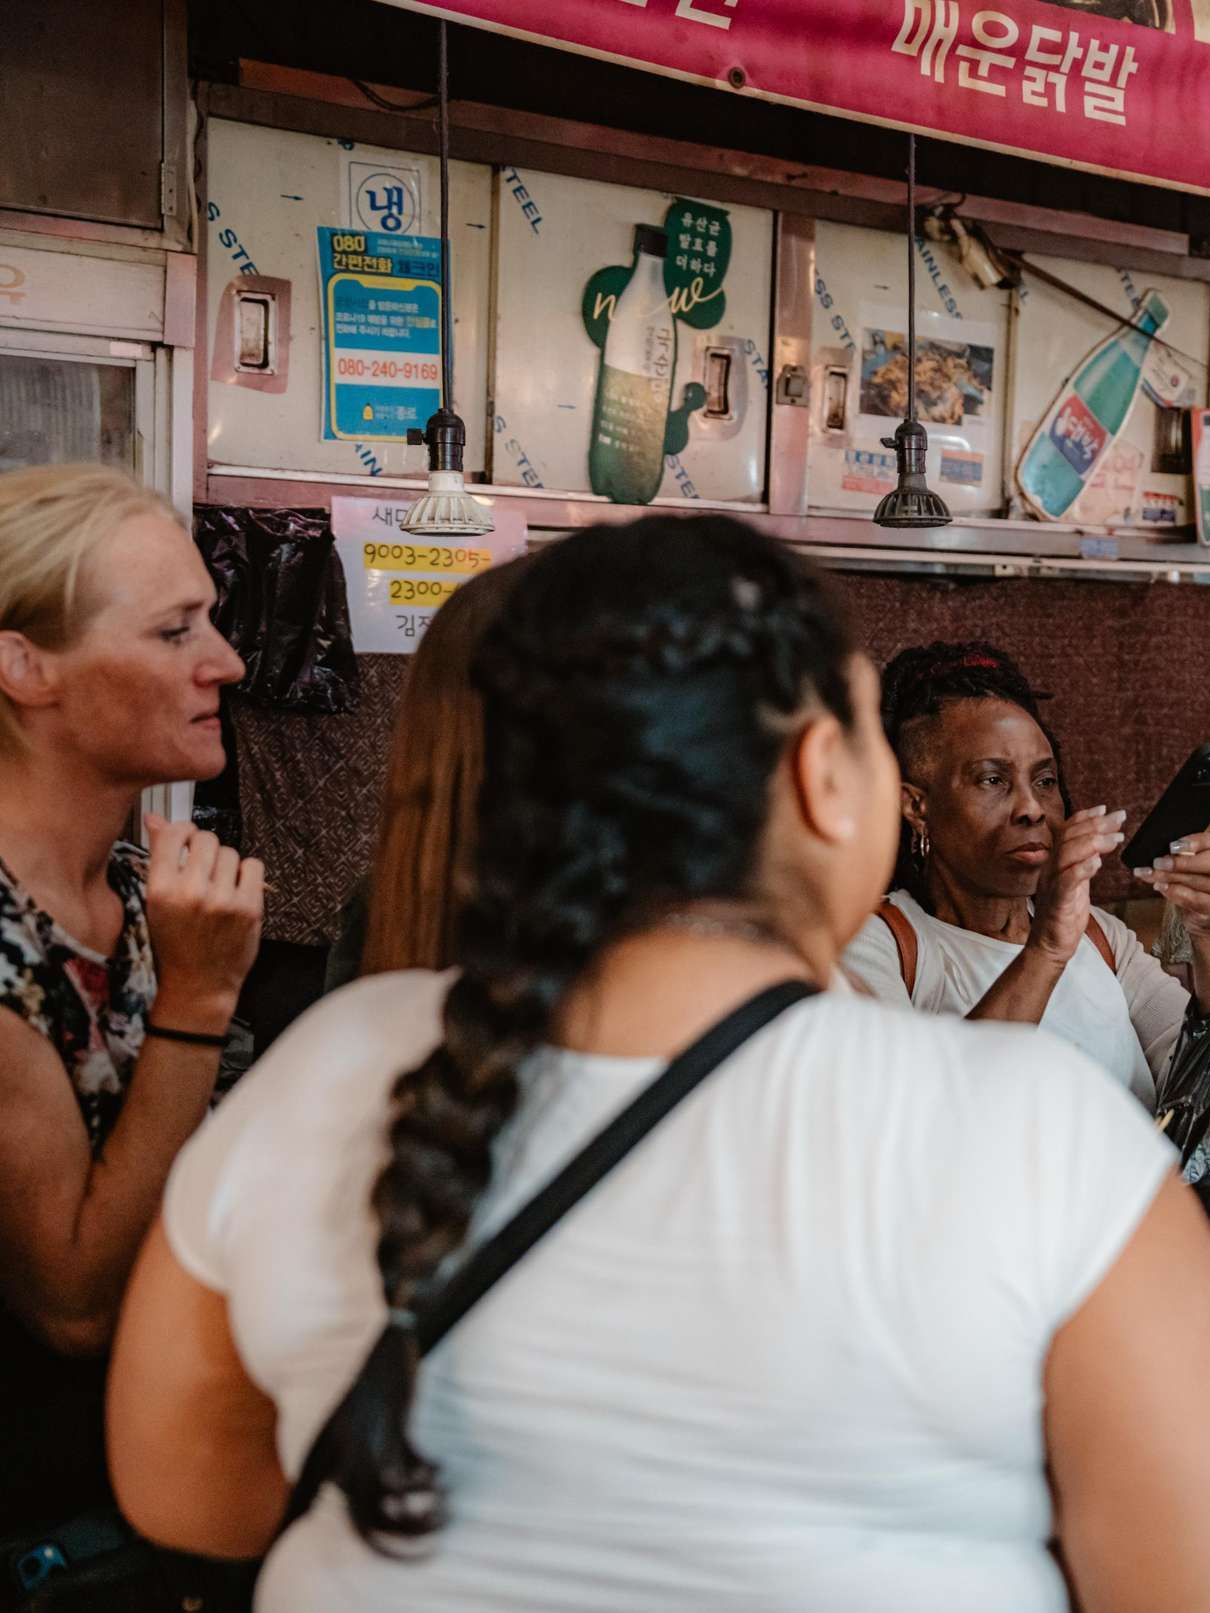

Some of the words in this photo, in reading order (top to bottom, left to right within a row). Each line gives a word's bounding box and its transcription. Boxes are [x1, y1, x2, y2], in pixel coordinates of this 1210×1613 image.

[892, 0, 1138, 126] 매운닭발
[365, 186, 404, 231] 냉
[500, 163, 545, 236] TEEL
[681, 211, 721, 236] 유산균
[333, 235, 365, 252] 080
[678, 233, 718, 257] 발효를
[333, 253, 392, 273] 간편전화
[675, 254, 716, 278] 더하다
[337, 358, 439, 380] 080-240-9169
[390, 579, 459, 600] 2300-
